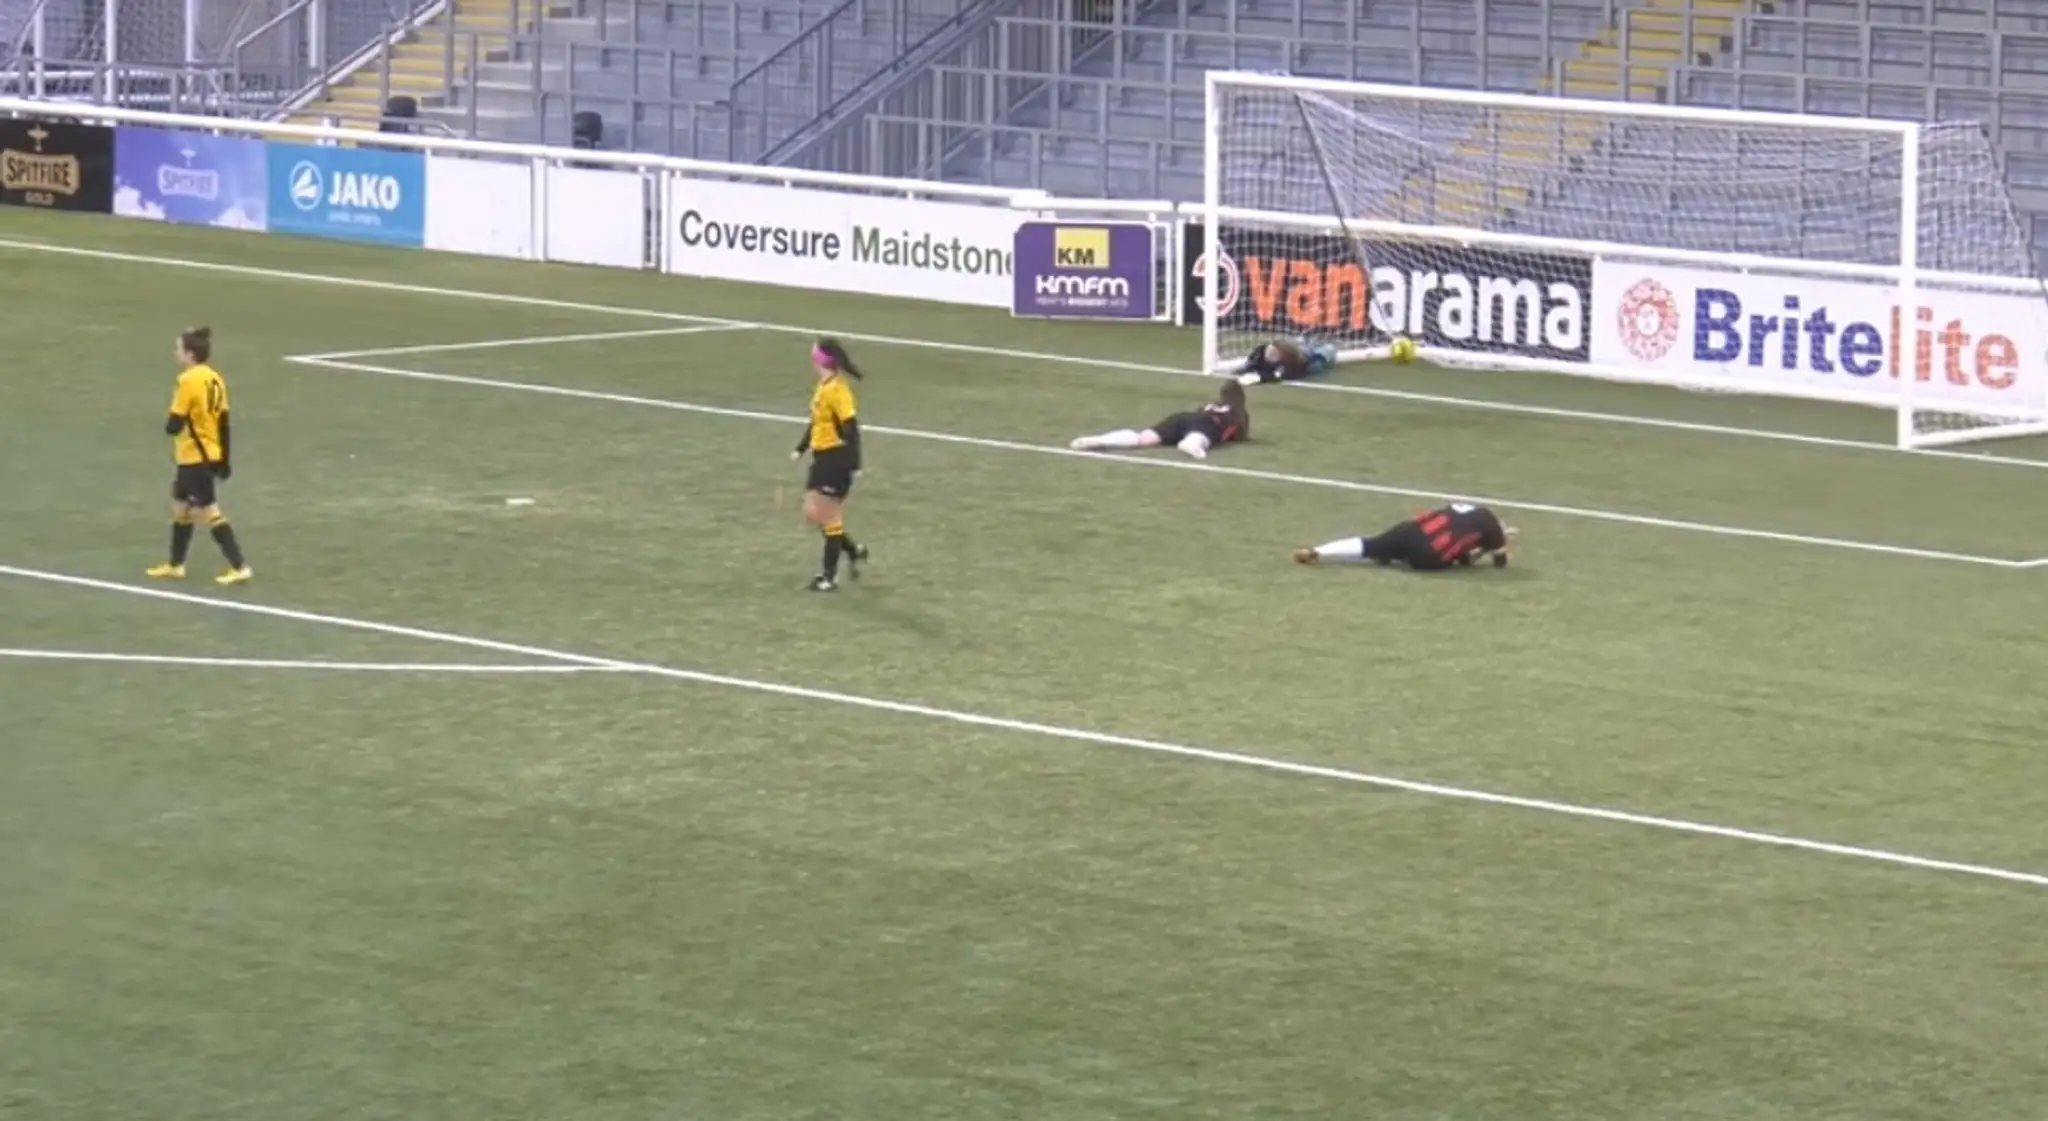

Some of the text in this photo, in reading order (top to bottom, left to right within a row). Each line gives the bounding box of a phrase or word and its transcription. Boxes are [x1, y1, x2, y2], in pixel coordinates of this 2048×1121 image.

[6, 156, 71, 187] SPITFIRE
[328, 170, 400, 210] JAKO
[679, 209, 841, 260] Coversure
[1057, 247, 1095, 265] KM
[1244, 255, 1583, 351] vanarama
[1692, 287, 2019, 390] Britelite
